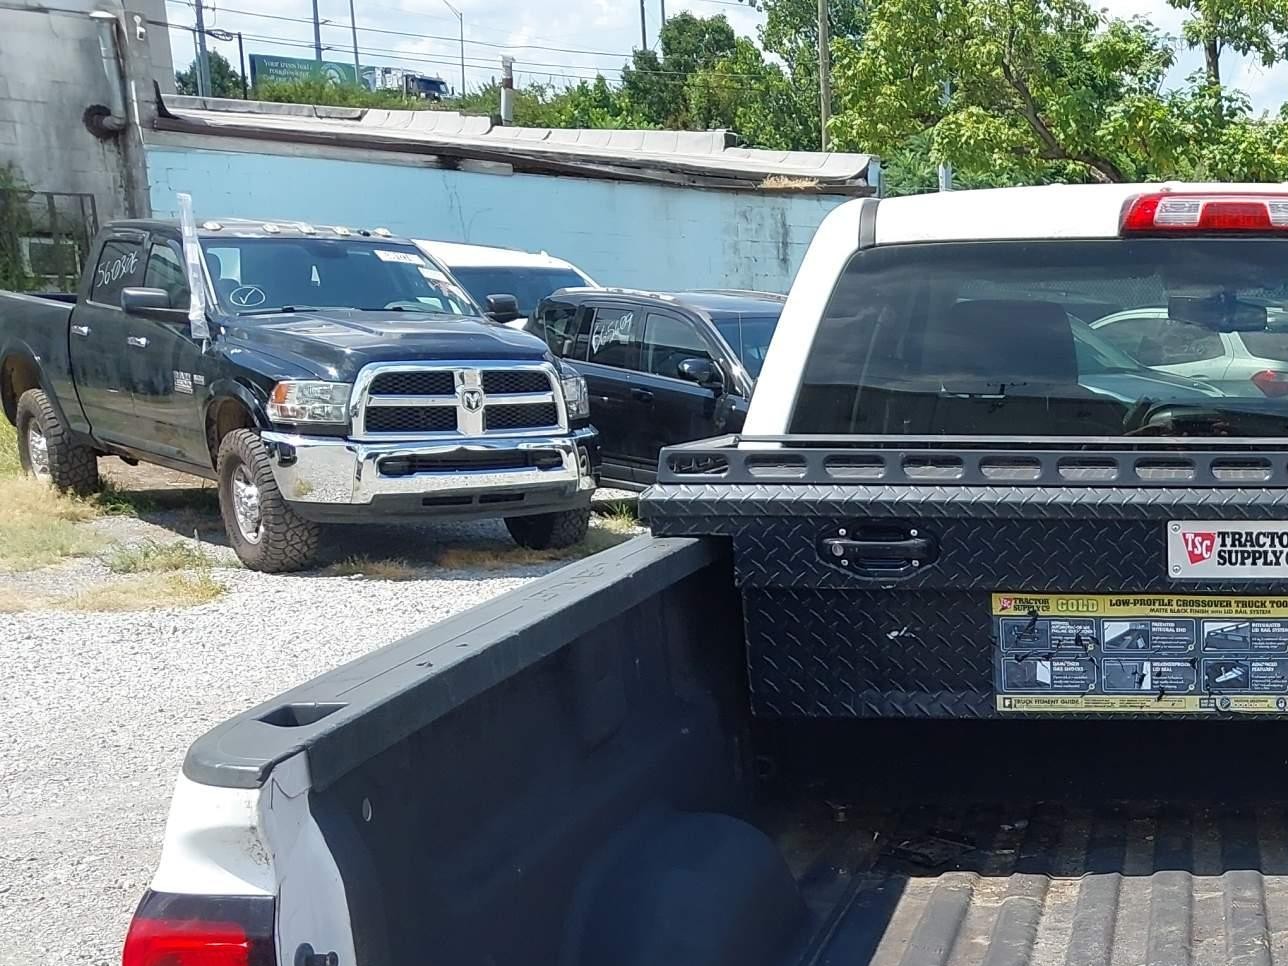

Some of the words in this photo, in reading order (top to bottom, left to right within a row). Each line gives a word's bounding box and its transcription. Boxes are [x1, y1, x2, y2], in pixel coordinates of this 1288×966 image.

[1217, 549, 1283, 566] SUPPLY
[1013, 597, 1050, 605] TRACTOR
[1057, 598, 1098, 612] GOLD
[1109, 598, 1173, 609] LOW-PROFILE
[1176, 599, 1232, 609] CROSSOVER
[1234, 599, 1267, 609] TRUCK
